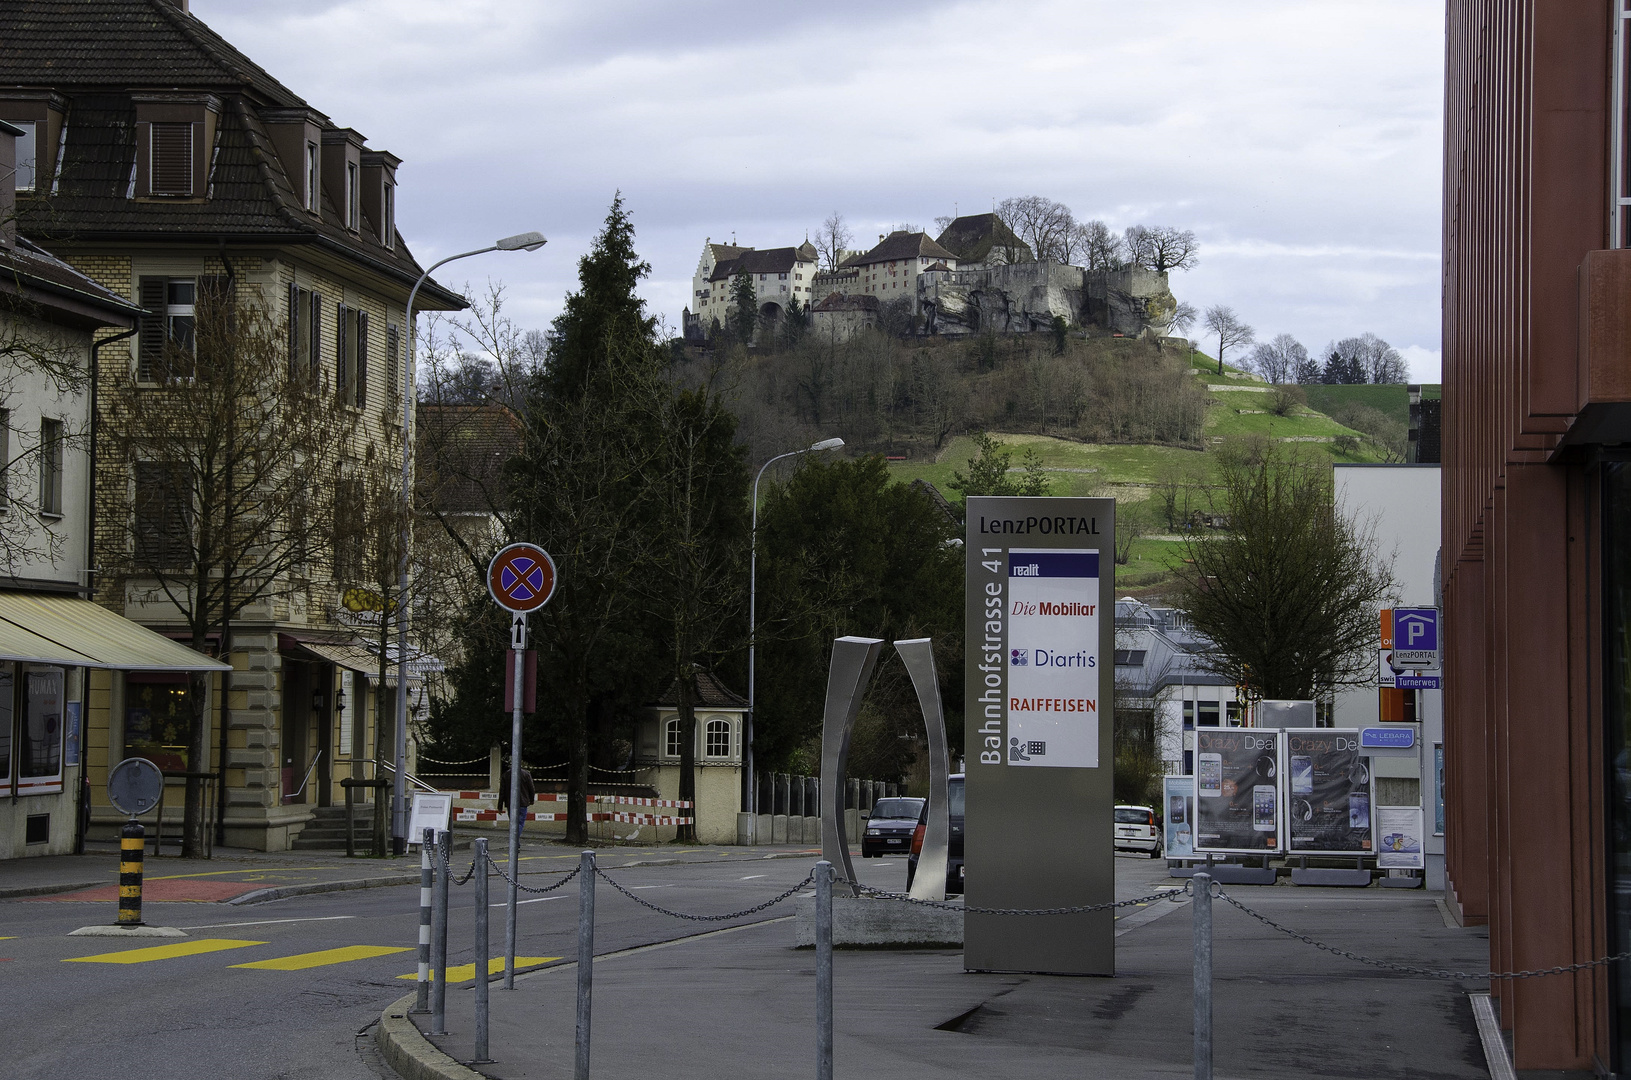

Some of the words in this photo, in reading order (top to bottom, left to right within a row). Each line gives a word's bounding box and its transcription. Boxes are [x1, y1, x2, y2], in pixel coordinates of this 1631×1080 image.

[980, 516, 1100, 535] LenzPORTAL
[981, 548, 1002, 574] 41
[1013, 563, 1040, 577] realit
[1011, 601, 1037, 616] Die
[1039, 602, 1096, 616] Mobiliar
[1408, 622, 1425, 646] P
[1035, 649, 1096, 668] Diartis
[1395, 651, 1437, 659] LenzPORTAL
[978, 581, 1002, 765] Bahnhofstrasse
[28, 679, 57, 695] HUMAX
[1398, 677, 1437, 689] Turnerweg
[1010, 697, 1096, 712] RAIFFEISEN
[1199, 734, 1240, 752] Crazy
[1244, 735, 1277, 750] Deal
[1289, 737, 1332, 754] Crazy
[1336, 737, 1359, 751] De
